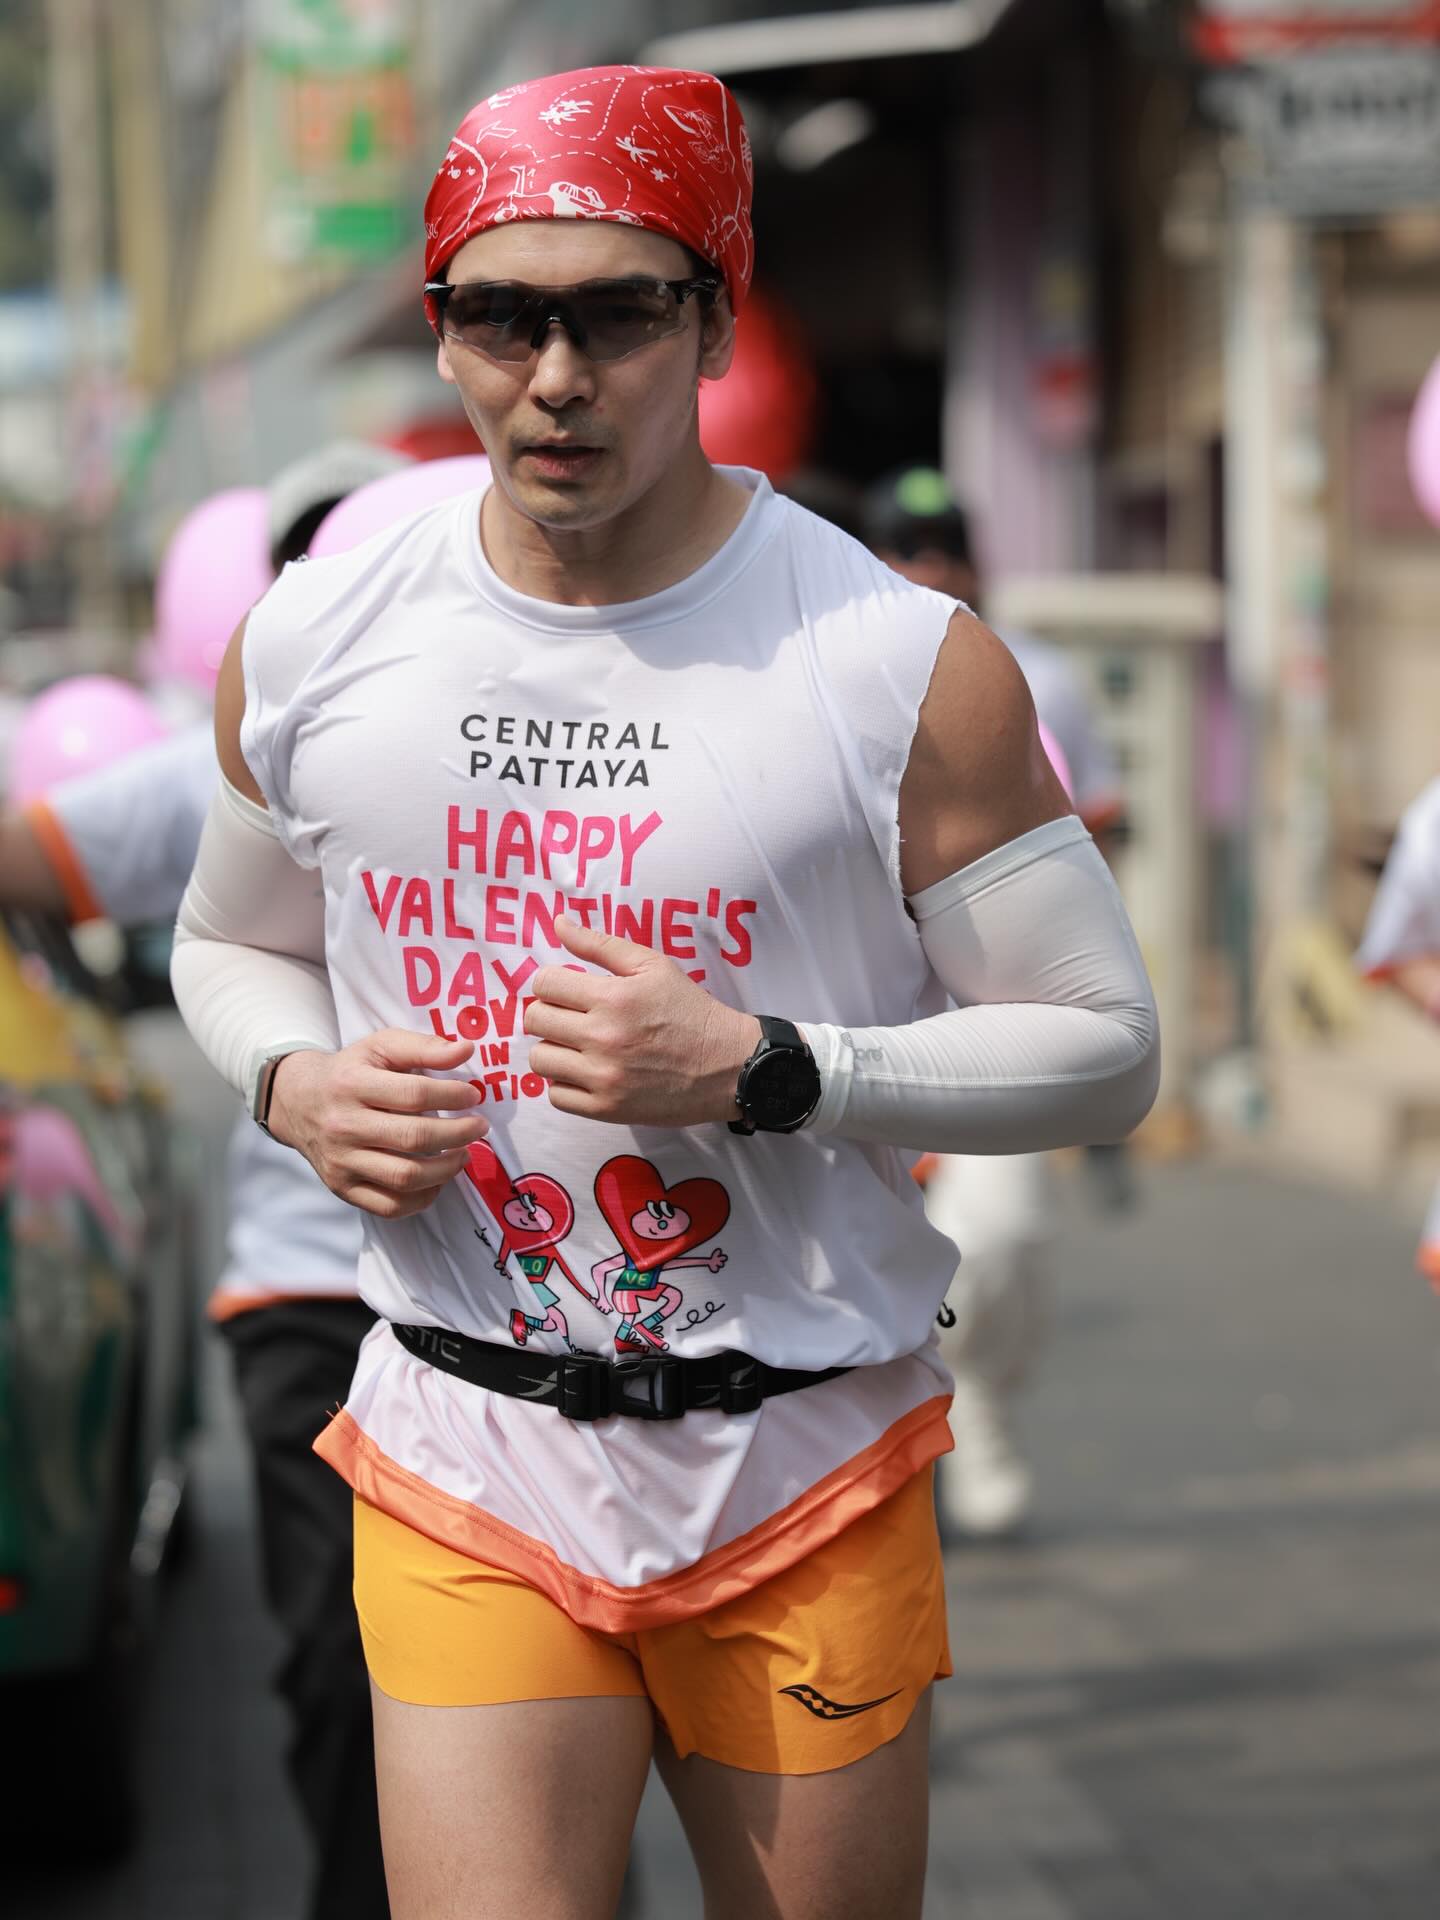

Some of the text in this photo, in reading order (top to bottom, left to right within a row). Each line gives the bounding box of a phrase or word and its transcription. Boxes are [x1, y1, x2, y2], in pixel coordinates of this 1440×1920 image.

[460, 714, 669, 750] CENTRAL
[469, 751, 650, 788] PATTAYA
[447, 805, 663, 887] HAPPY
[361, 871, 757, 968] VALENTINE'S
[403, 946, 539, 1007] DAY
[480, 1041, 509, 1067] IN
